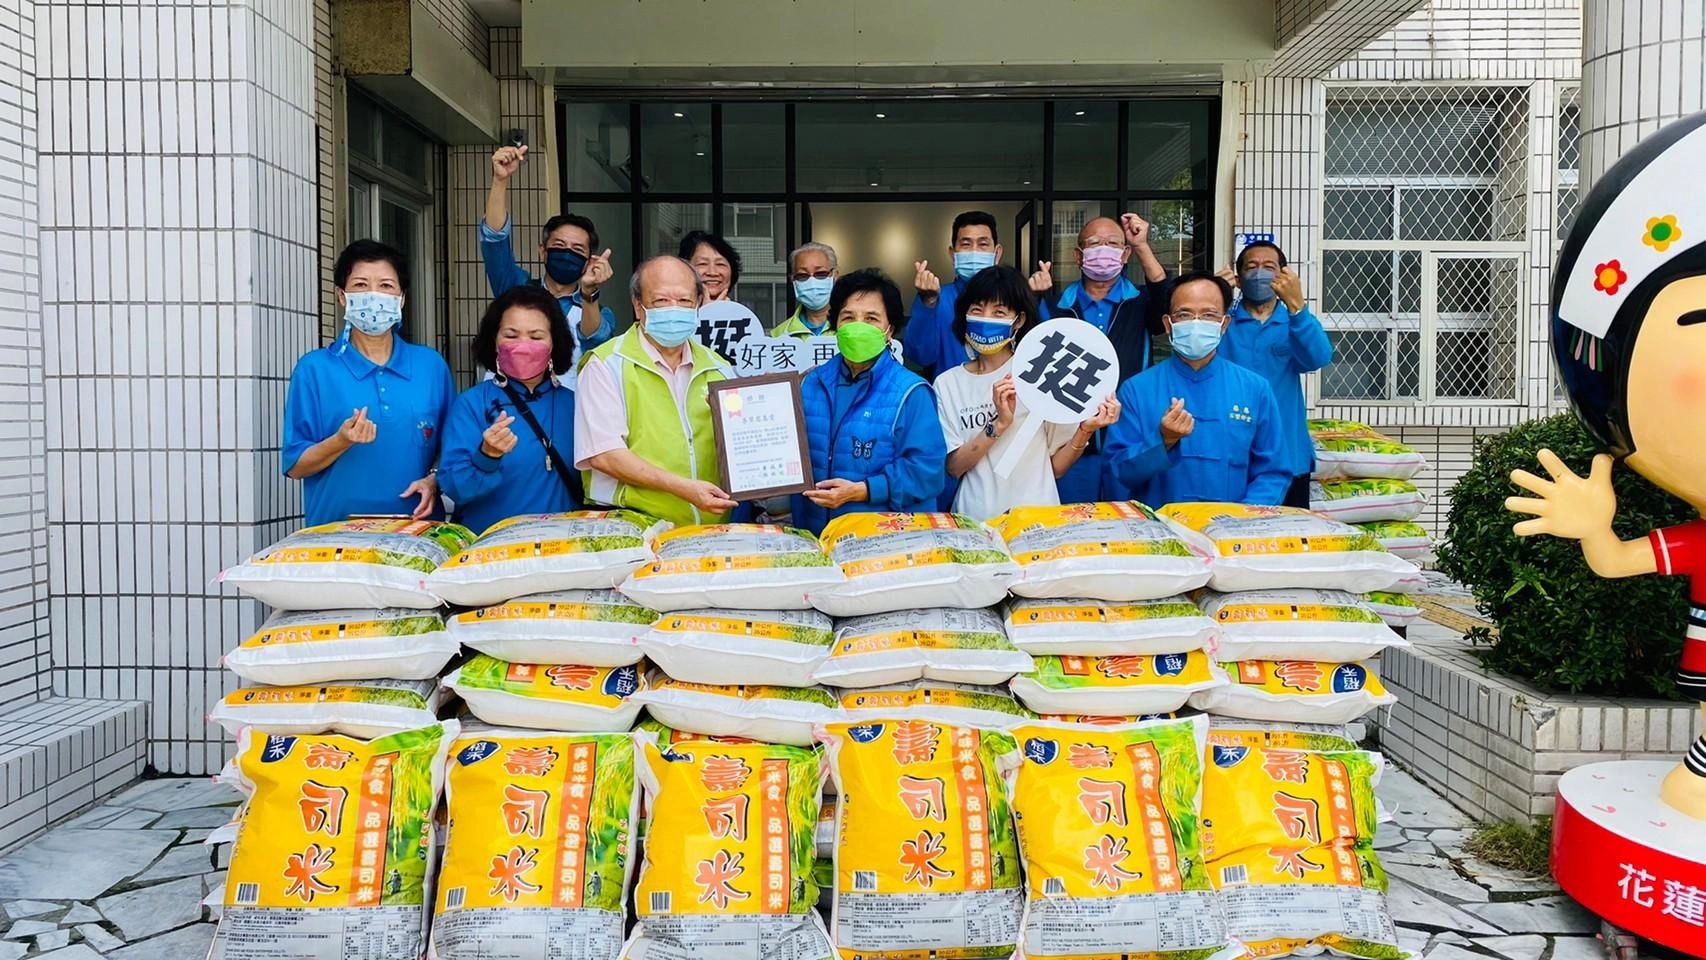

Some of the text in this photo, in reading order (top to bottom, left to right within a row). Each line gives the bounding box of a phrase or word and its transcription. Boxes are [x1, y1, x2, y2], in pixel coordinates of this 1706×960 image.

[695, 318, 751, 366] 挺
[741, 343, 836, 370] 好家 再
[1018, 330, 1112, 414] 挺
[1165, 655, 1182, 671] 稻
[488, 746, 558, 902] 壽司米
[695, 755, 751, 909] 壽司米
[892, 720, 954, 888] 壽司米
[1618, 863, 1706, 927] 花蓮
